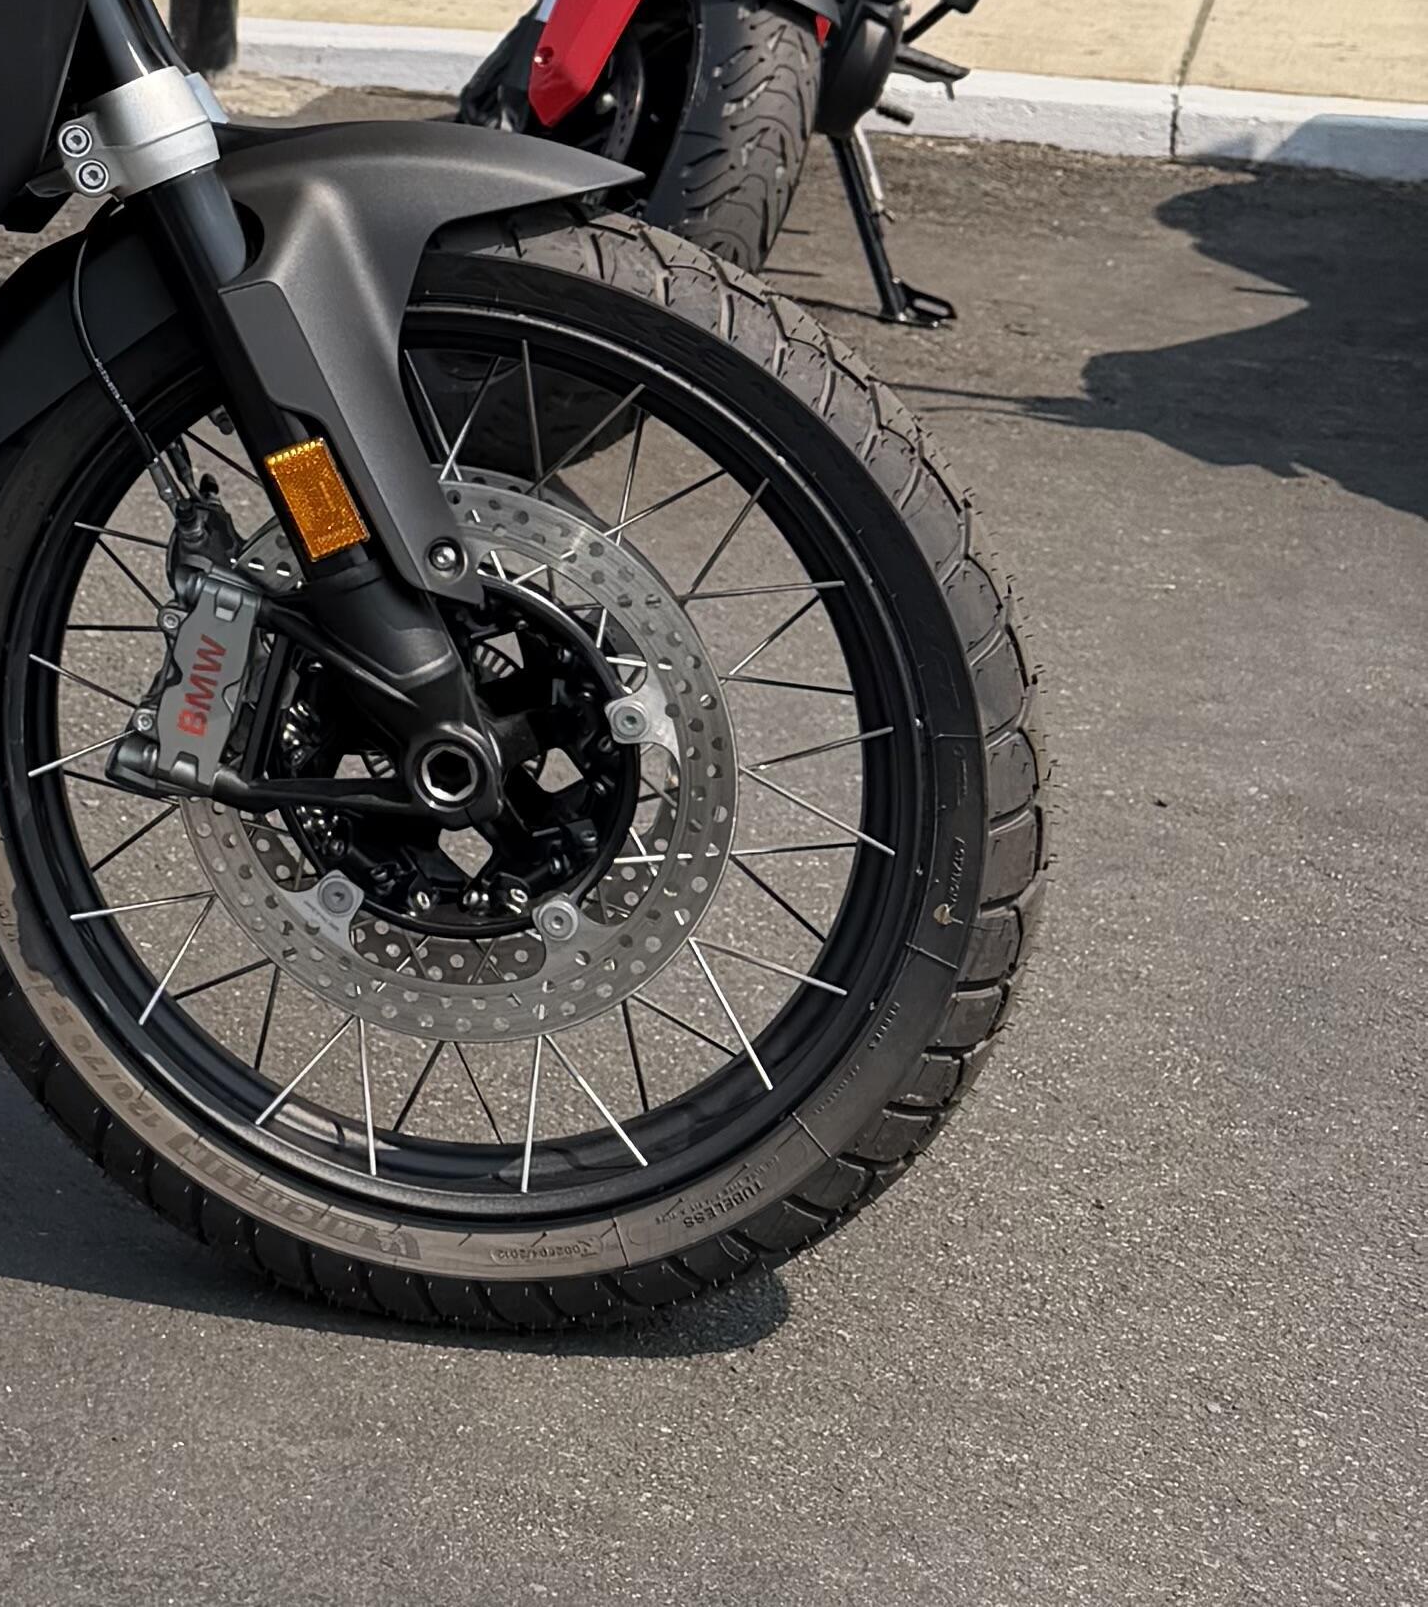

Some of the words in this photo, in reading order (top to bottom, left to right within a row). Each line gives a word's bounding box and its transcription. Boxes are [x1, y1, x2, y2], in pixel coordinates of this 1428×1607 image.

[176, 633, 227, 738] BMW
[177, 1144, 368, 1244] MICHELIN
[682, 1179, 765, 1229] TUBELESS
